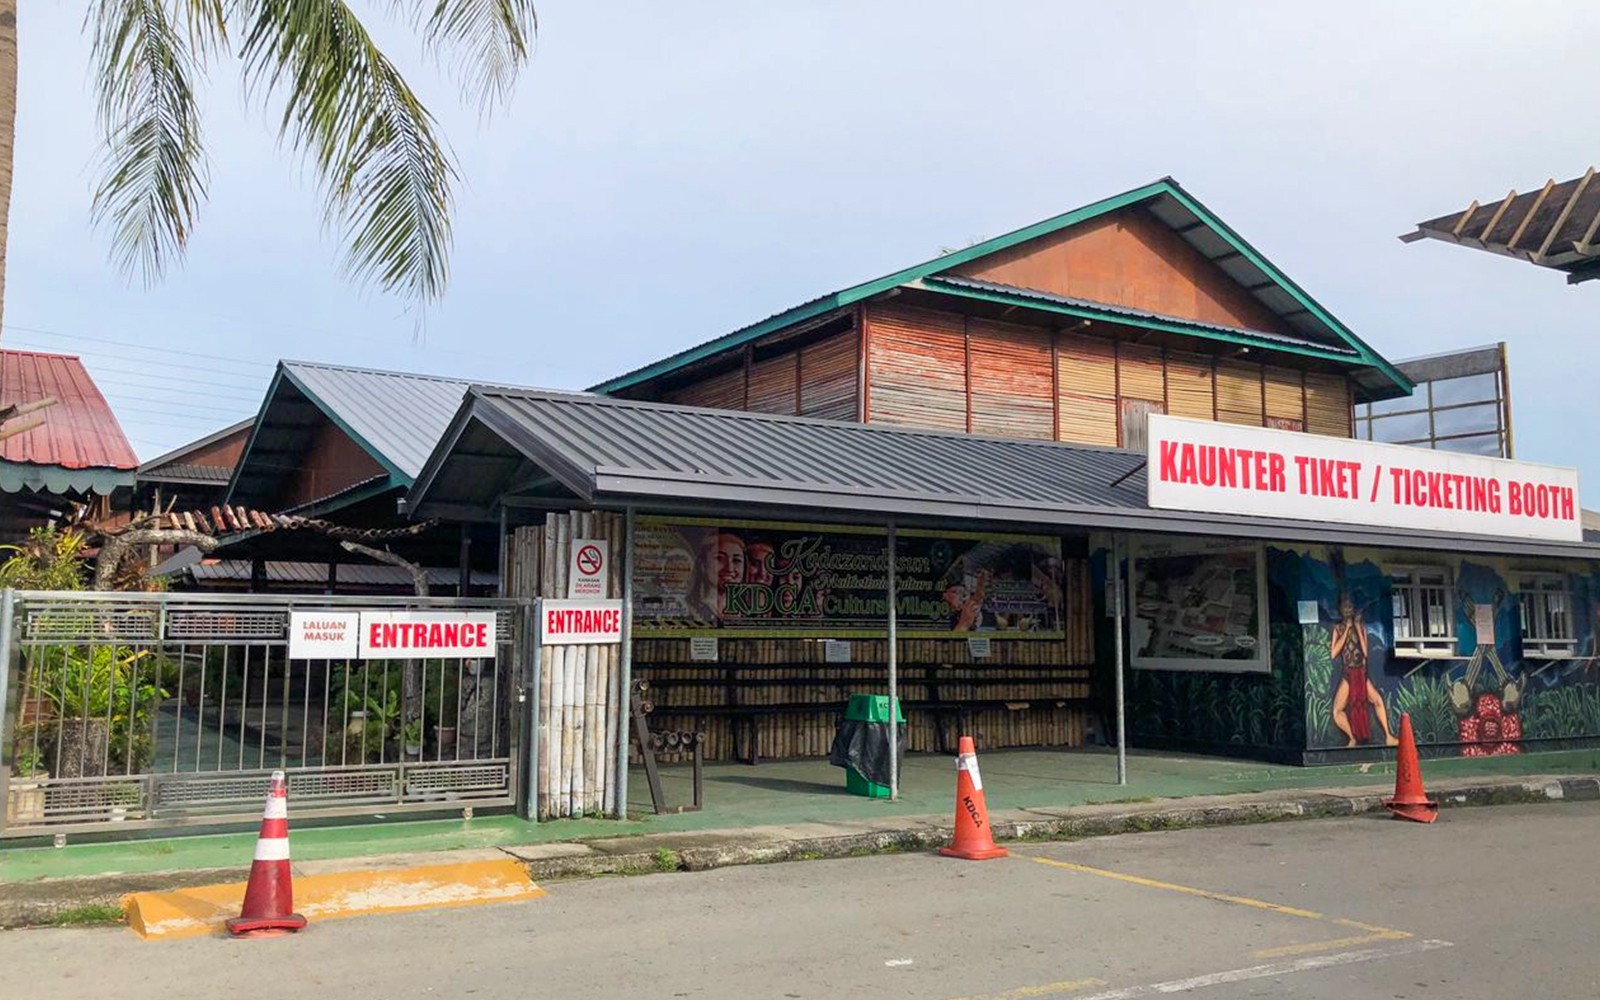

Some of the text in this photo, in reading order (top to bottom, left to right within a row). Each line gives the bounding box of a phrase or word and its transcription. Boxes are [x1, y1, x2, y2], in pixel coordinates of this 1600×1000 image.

[1159, 440, 1575, 521] KAUNTER TIKET / TICKETING BOOTH
[766, 535, 931, 578] Kadazandsun
[723, 583, 821, 615] KDCA
[303, 620, 347, 630] LALUAN
[304, 631, 345, 642] MASUK
[369, 623, 488, 648] ENTRANCE
[547, 609, 620, 635] ENTRANCE
[962, 796, 983, 829] KDCA
